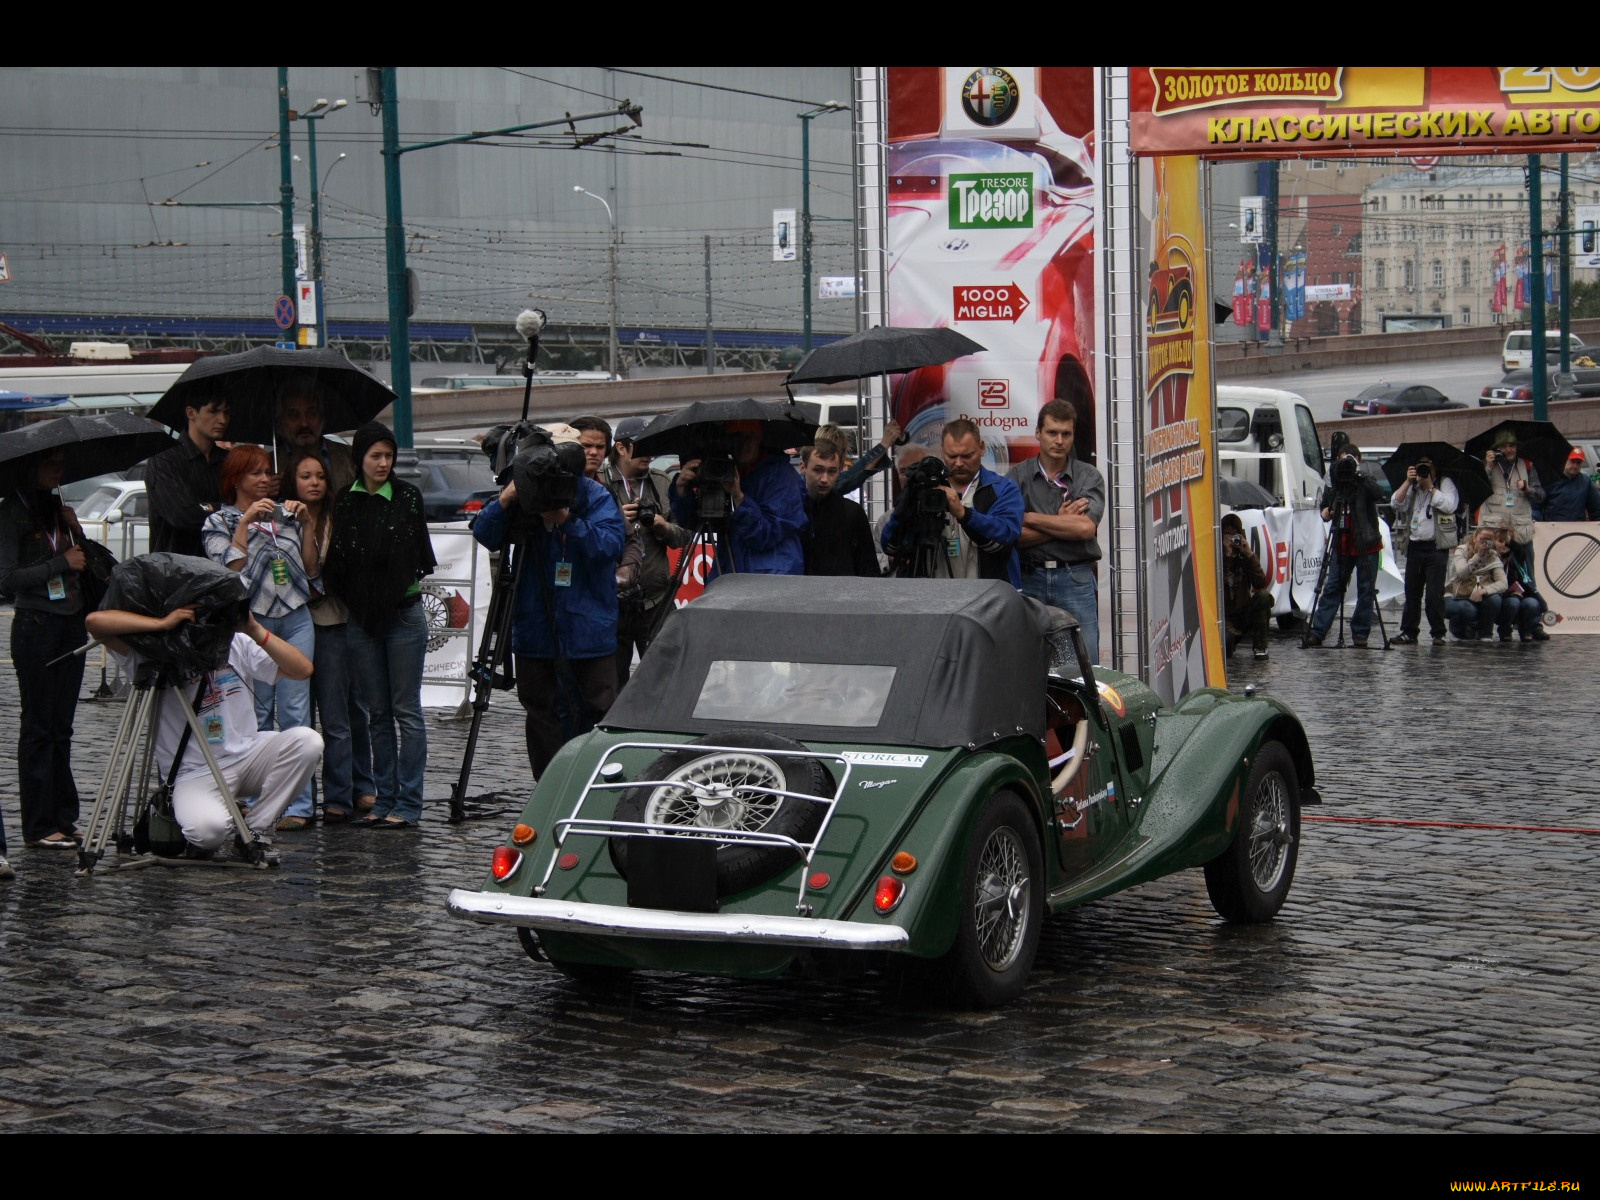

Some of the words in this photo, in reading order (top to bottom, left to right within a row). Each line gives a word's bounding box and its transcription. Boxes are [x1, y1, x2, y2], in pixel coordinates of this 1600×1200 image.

[963, 72, 983, 99] ALFA
[988, 68, 1018, 97] ROMEO
[1164, 75, 1249, 102] ЗОЛОТОЕ
[1254, 72, 1331, 94] КОЛЬЦО
[1207, 109, 1493, 143] КЛАССИЧЕСКИХ
[1502, 107, 1600, 136] АВТО
[980, 178, 1028, 188] TRESORE
[952, 180, 1029, 223] Трезор
[961, 289, 1009, 302] 1000
[958, 305, 1013, 318] MIGLIA
[1180, 448, 1204, 481] RALLY
[858, 779, 898, 790] Morgan
